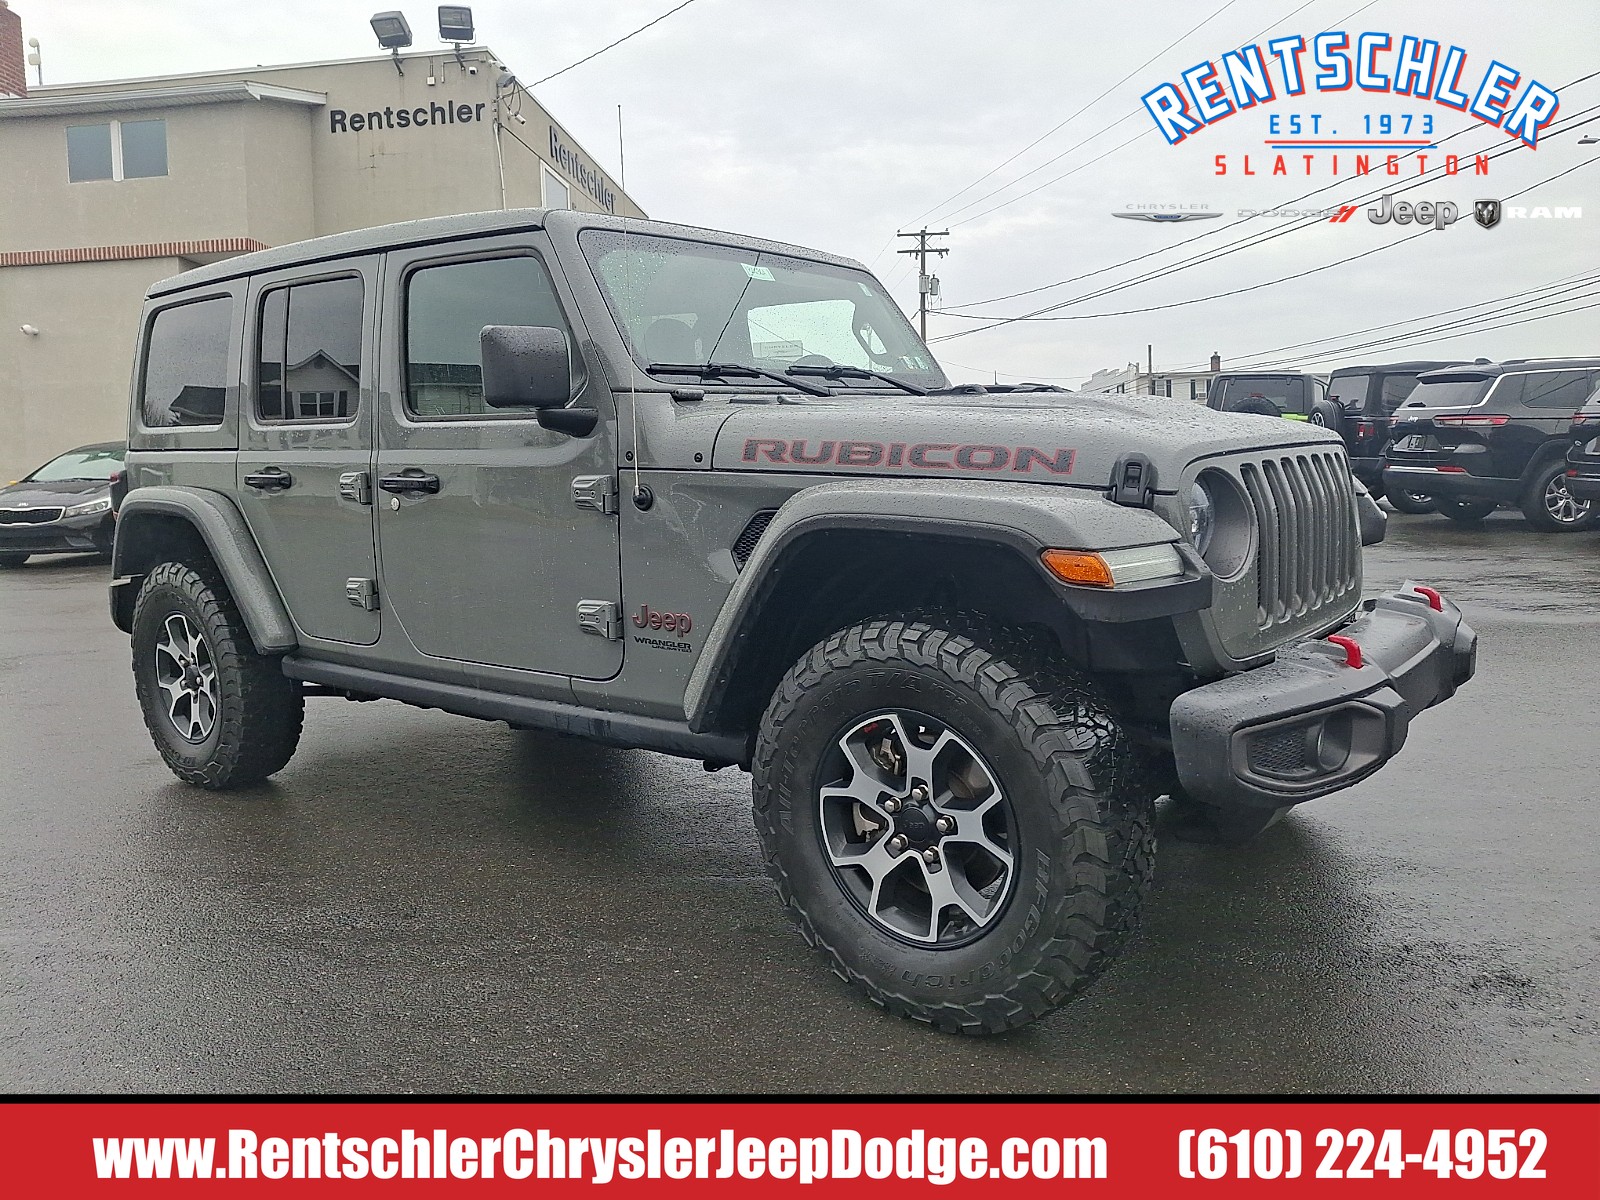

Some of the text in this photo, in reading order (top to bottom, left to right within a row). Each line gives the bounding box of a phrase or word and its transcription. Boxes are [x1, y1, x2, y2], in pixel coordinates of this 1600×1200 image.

[330, 100, 485, 133] Rentschler
[549, 125, 616, 214] Rentschler
[742, 439, 1076, 475] RUBICON
[632, 603, 692, 638] Jeep
[633, 635, 692, 650] WRANGLER
